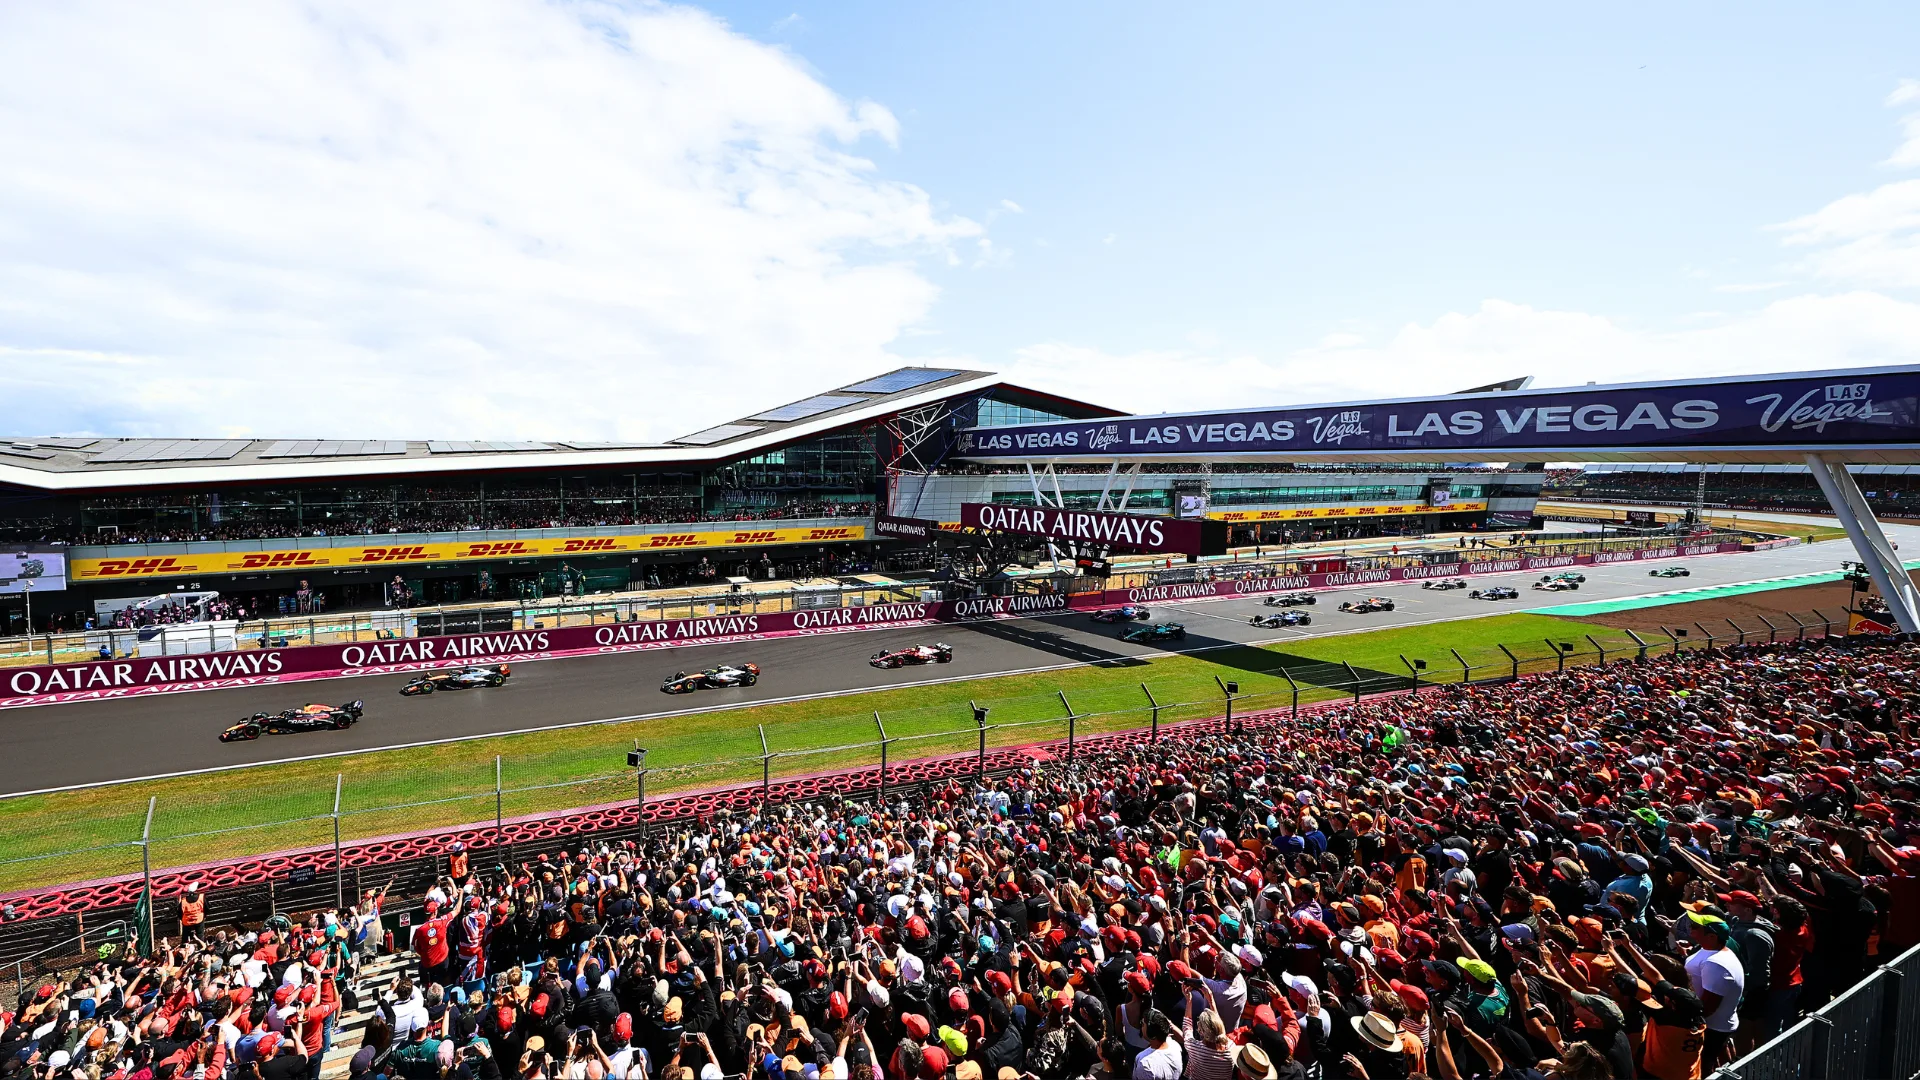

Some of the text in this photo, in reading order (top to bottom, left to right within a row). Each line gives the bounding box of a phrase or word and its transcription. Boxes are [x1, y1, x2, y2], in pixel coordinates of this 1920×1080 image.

[1828, 384, 1869, 400] LAS
[1341, 412, 1360, 423] LAS
[1388, 400, 1720, 437] LAS VEGAS
[1746, 389, 1892, 433] Vegas
[1106, 425, 1118, 434] LAS
[1130, 420, 1294, 444] LAS VEGAS
[1306, 414, 1370, 445] Vegas
[978, 432, 1078, 450] LAS VEGAS
[1085, 428, 1123, 450] Vegas
[1224, 512, 1245, 521] DHL
[1295, 510, 1314, 518] DHL
[810, 528, 850, 540] DHL
[878, 521, 926, 536] QATAR AIRWAYS
[980, 506, 1164, 546] QATAR AIRWAYS
[563, 538, 618, 552] DHL
[650, 534, 700, 548] DHL
[734, 532, 778, 544] DHL
[362, 546, 430, 562] DHL
[468, 542, 528, 556] DHL
[1594, 551, 1634, 562] QATAR AIRWAYS
[1642, 549, 1678, 559] QATAR AIRWAYS
[1685, 545, 1717, 555] QATAR AIRWAYS
[98, 558, 184, 576] DHL
[242, 552, 316, 568] DHL
[1470, 561, 1520, 574] QATAR AIRWAYS
[1528, 556, 1574, 568] QATAR AIRWAYS
[1326, 570, 1391, 586] QATAR AIRWAYS
[1402, 564, 1459, 579] QATAR AIRWAYS
[1129, 583, 1216, 602] QATAR AIRWAYS
[1236, 576, 1309, 593] QATAR AIRWAYS
[955, 599, 1004, 616] QATAR
[1008, 594, 1065, 611] AIRWAYS
[794, 604, 926, 628] QATAR AIRWAYS
[596, 616, 758, 646] QATAR AIRWAYS
[342, 632, 549, 667] QATAR AIRWAYS
[598, 633, 765, 652] QATAR AIRWAYS
[340, 652, 552, 676] QATAR AIRWAYS
[10, 652, 282, 695] QATAR AIRWAYS
[0, 675, 280, 706] QATAR AIRWAYS
